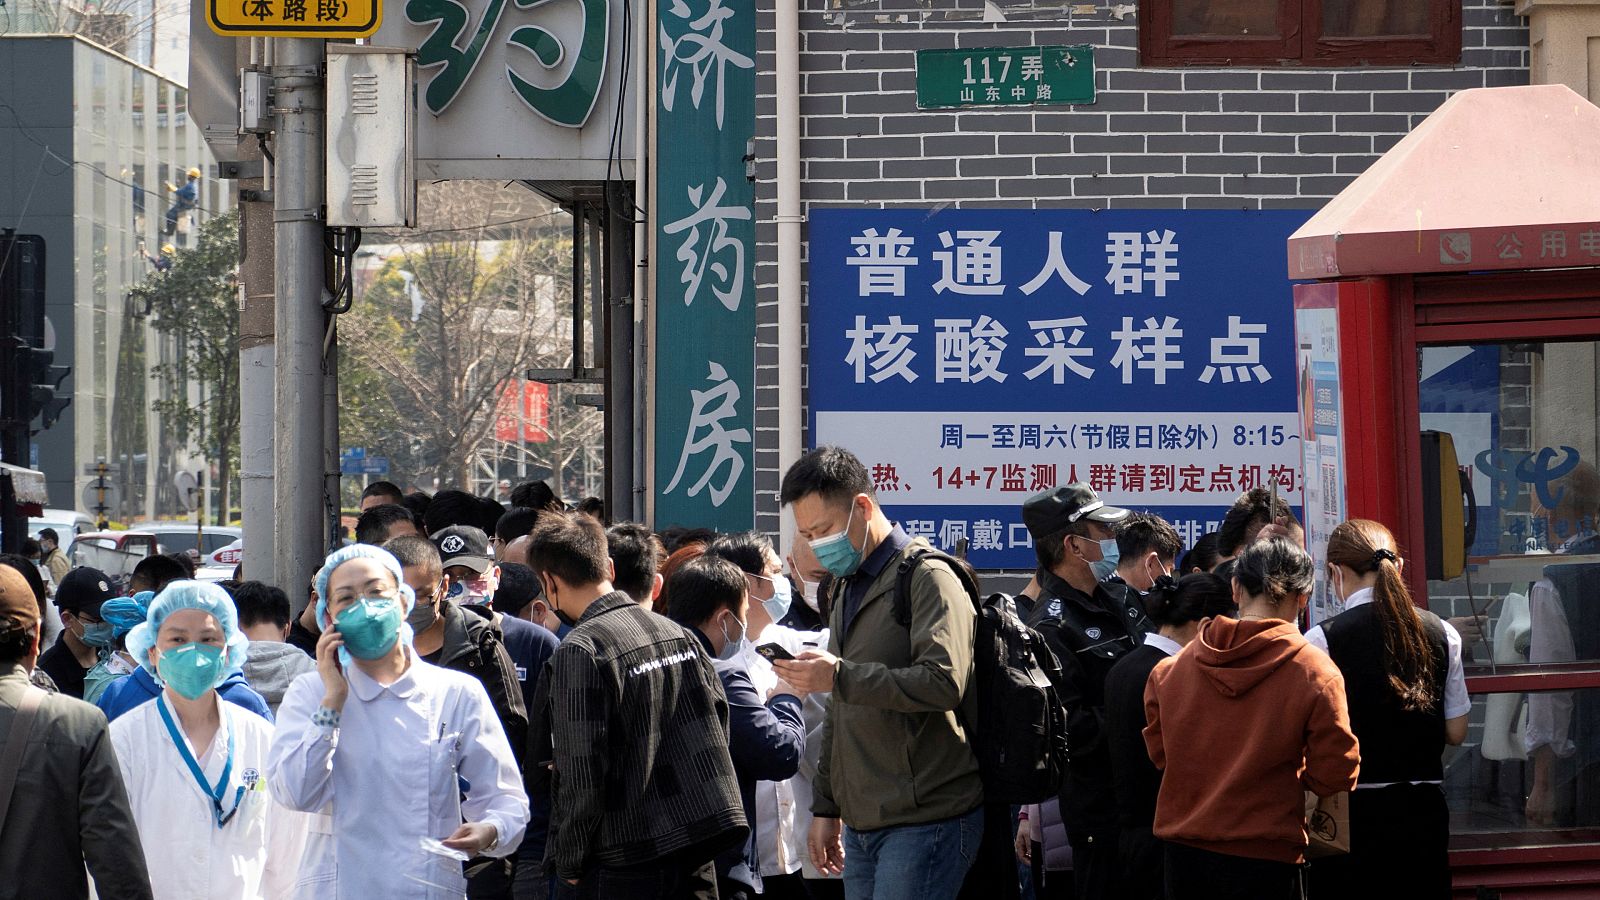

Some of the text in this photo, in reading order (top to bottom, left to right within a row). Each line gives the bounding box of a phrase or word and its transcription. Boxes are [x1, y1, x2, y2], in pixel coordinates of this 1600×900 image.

[960, 85, 1052, 102] 山东中路
[845, 227, 1181, 297] 普通人群
[844, 315, 1273, 385] 核酸采样点
